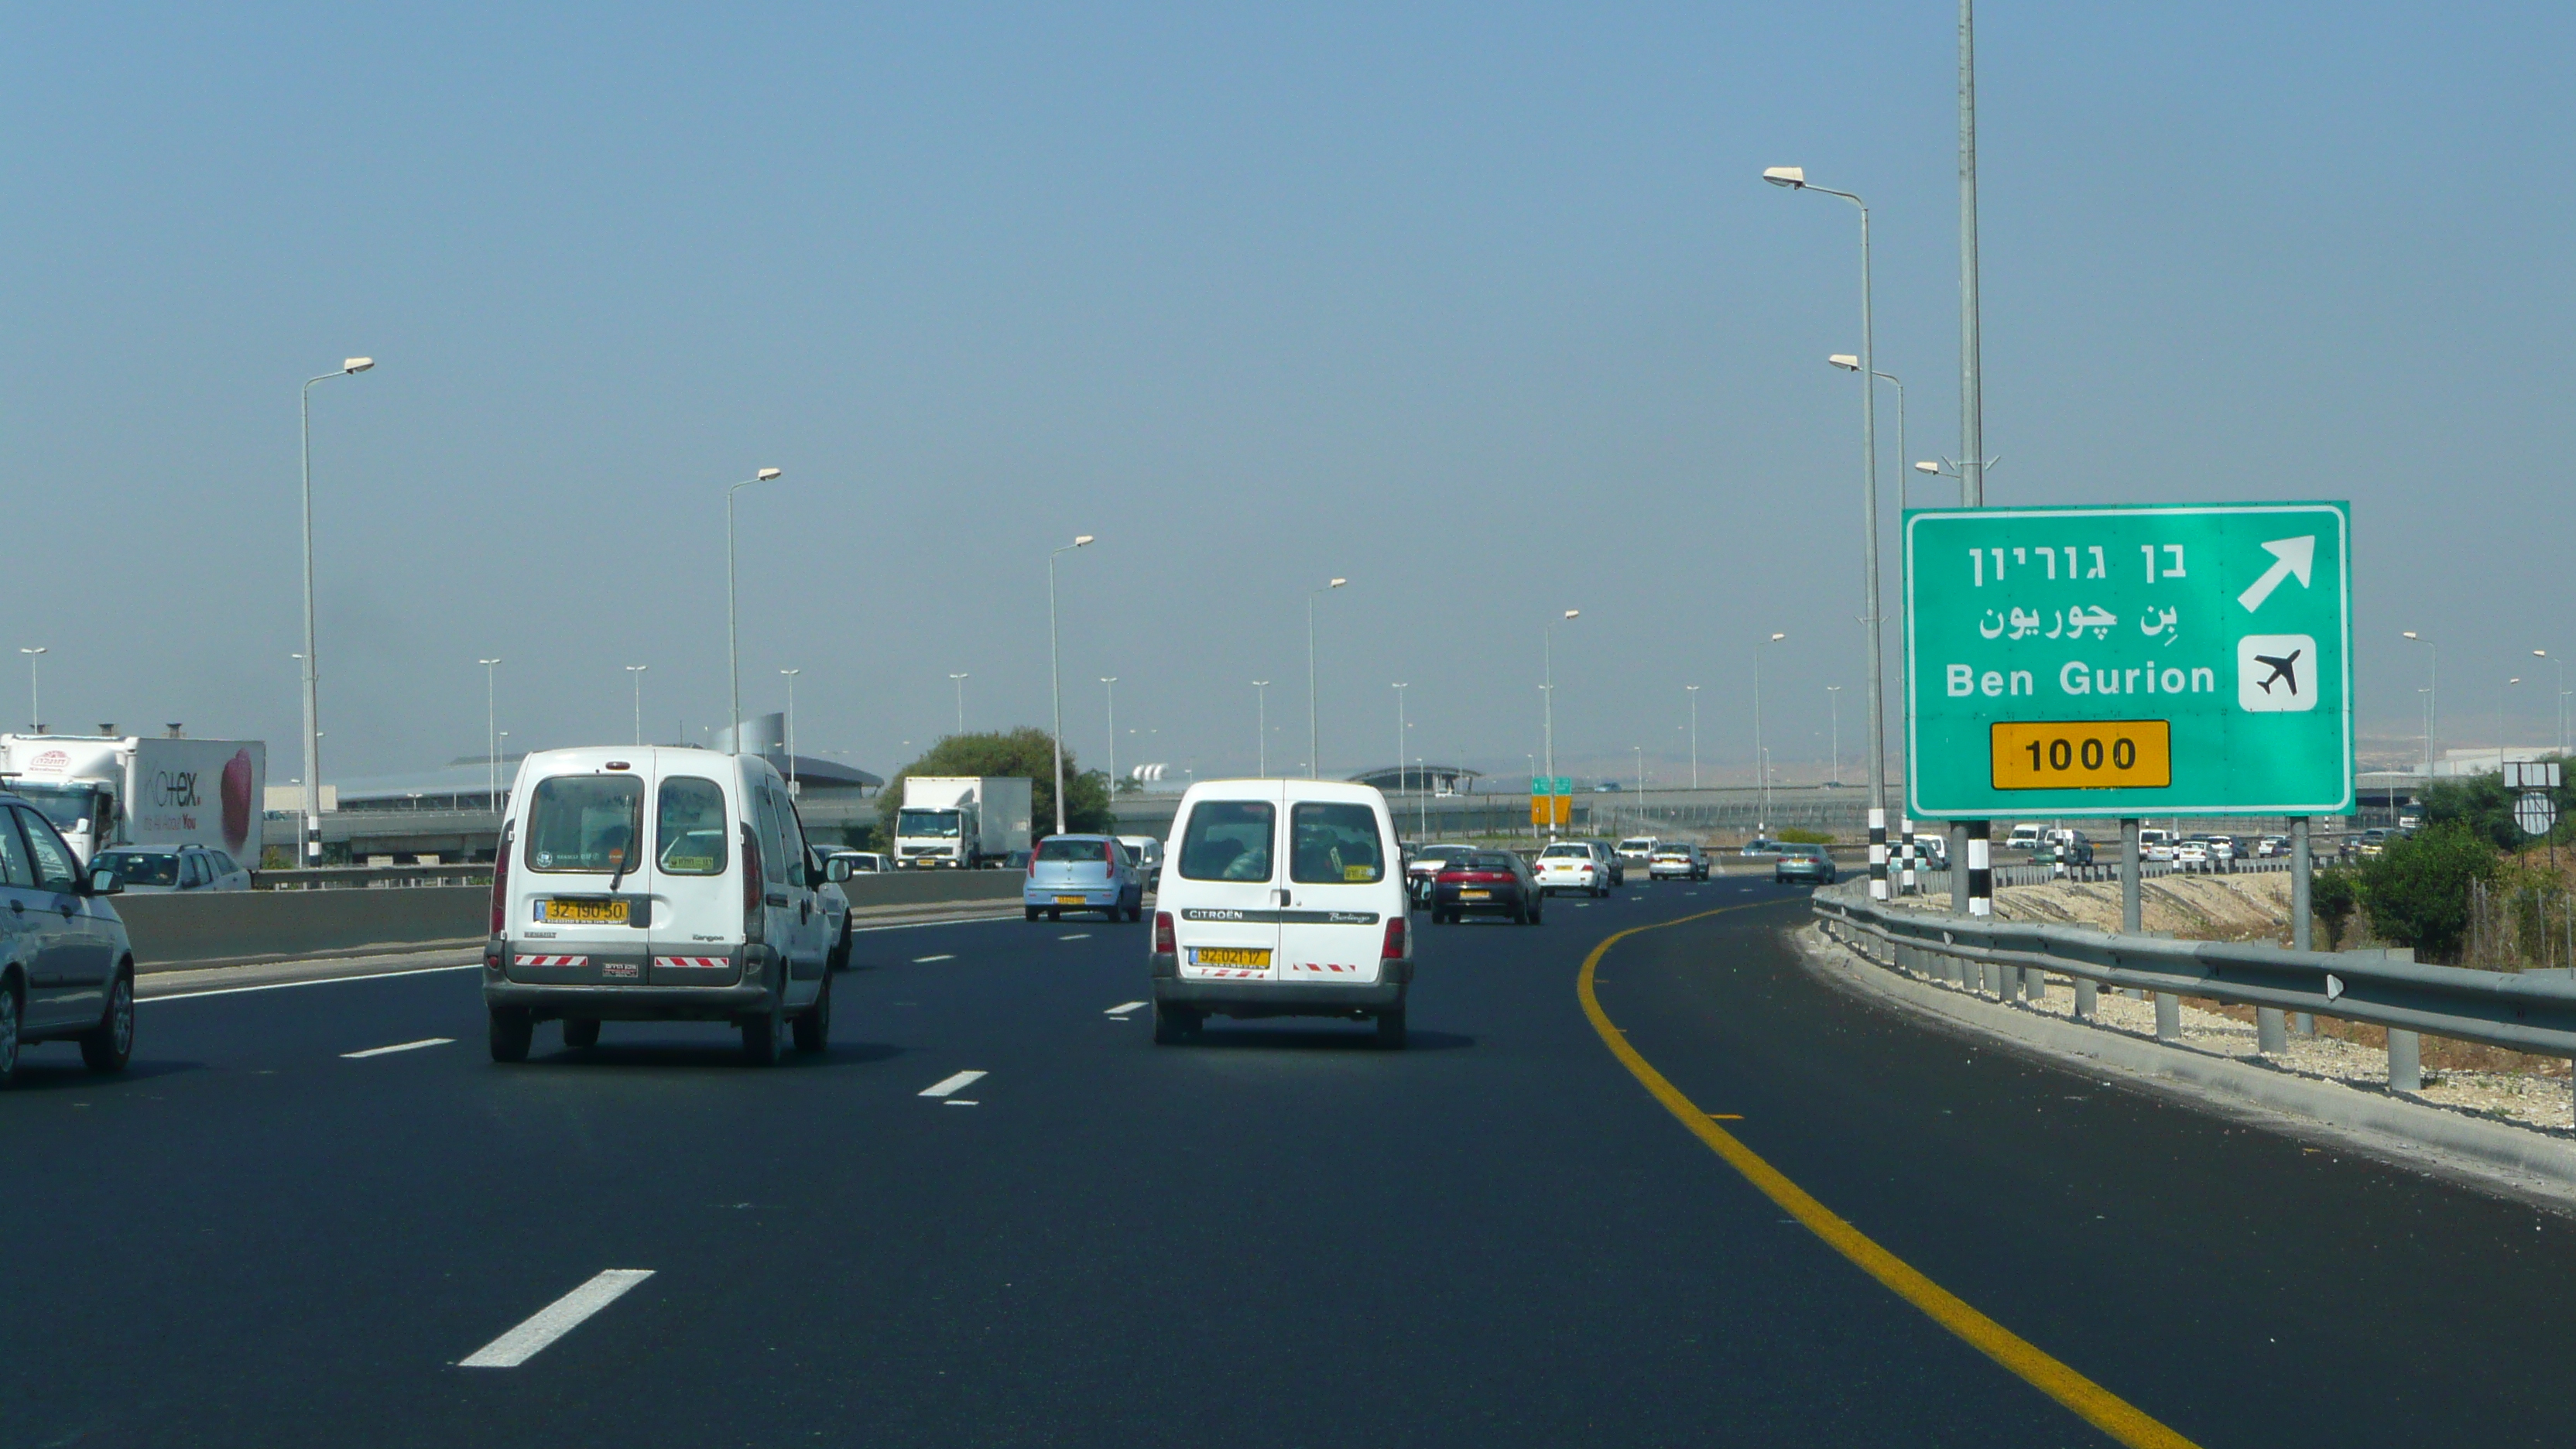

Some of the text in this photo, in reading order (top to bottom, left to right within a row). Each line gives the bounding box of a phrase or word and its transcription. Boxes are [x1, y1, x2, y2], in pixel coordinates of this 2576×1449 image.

[1969, 544, 2186, 587] בן גוריון
[1947, 660, 2215, 697] Ben Gurion
[2026, 738, 2136, 772] 1000
[182, 814, 197, 830] You
[1190, 909, 1243, 920] CITROËN
[693, 933, 724, 942] Kangoo
